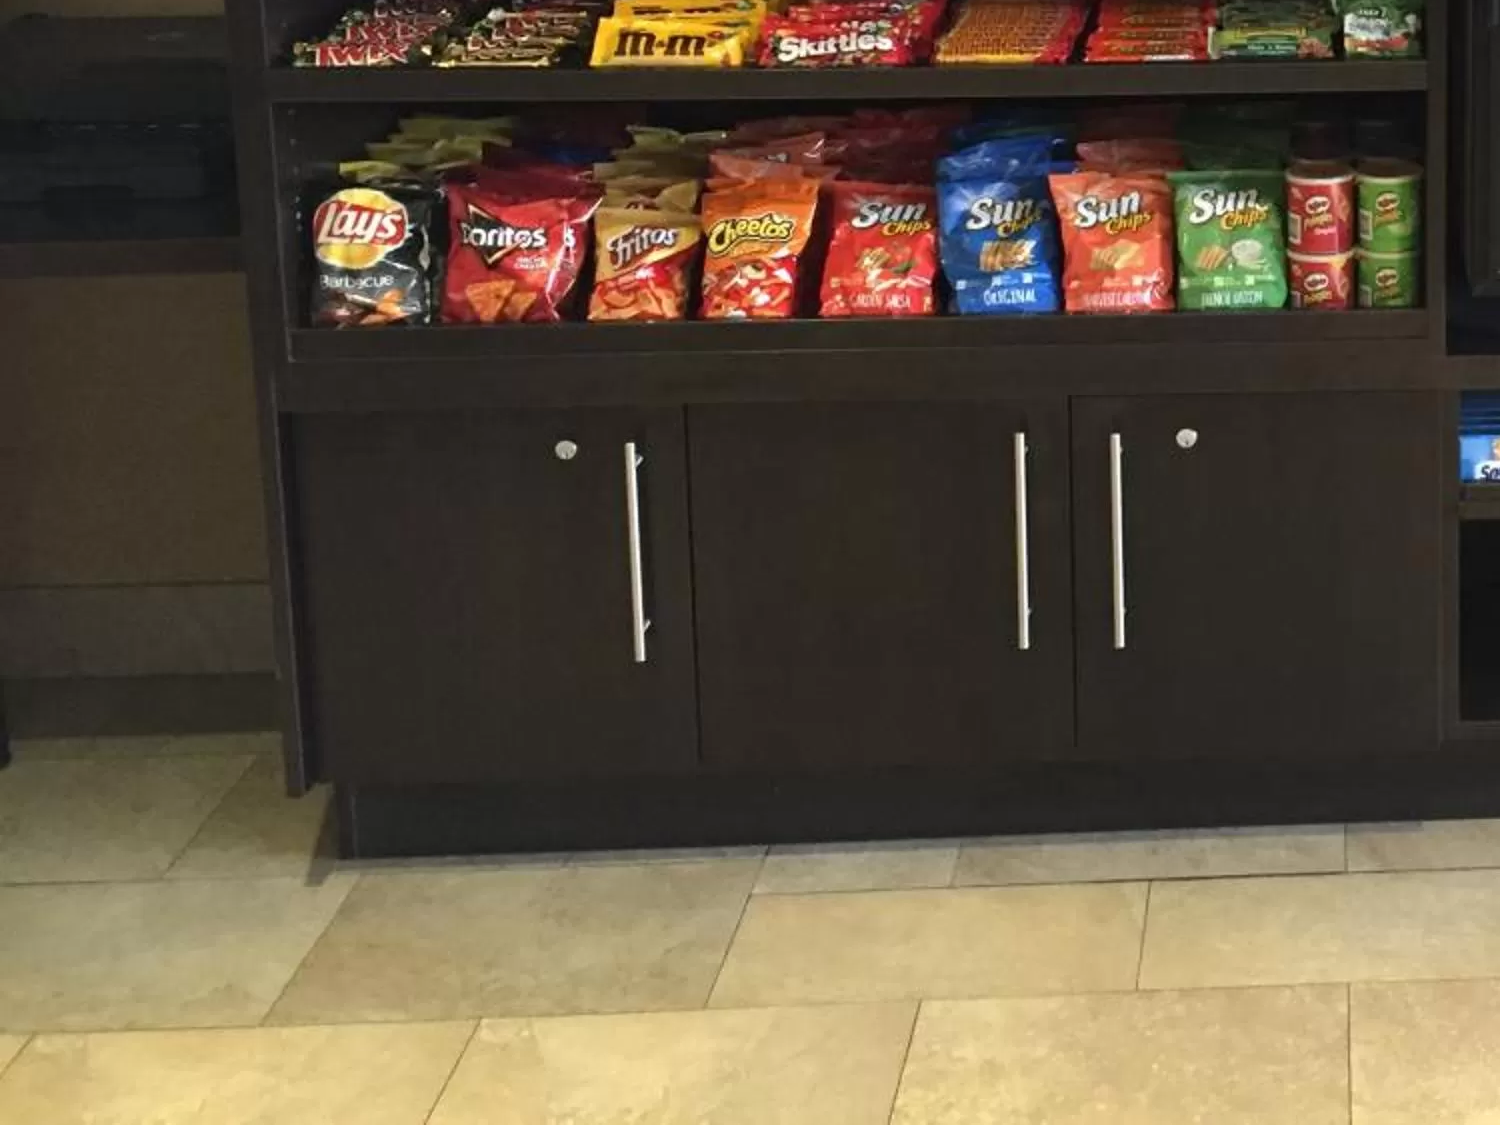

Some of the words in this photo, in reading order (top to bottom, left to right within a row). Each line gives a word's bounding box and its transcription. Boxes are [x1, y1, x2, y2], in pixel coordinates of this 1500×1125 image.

[778, 32, 894, 62] Skittles
[852, 202, 927, 228] Sun
[966, 197, 1034, 230] Sun
[1074, 189, 1141, 227] Sun
[1189, 188, 1260, 224] Sun
[1220, 210, 1268, 229] Chips
[462, 222, 547, 247] Doritos
[709, 213, 795, 254] Cheetos
[882, 220, 931, 236] Chips
[1105, 212, 1152, 234] Chips
[606, 227, 679, 268] Fritos
